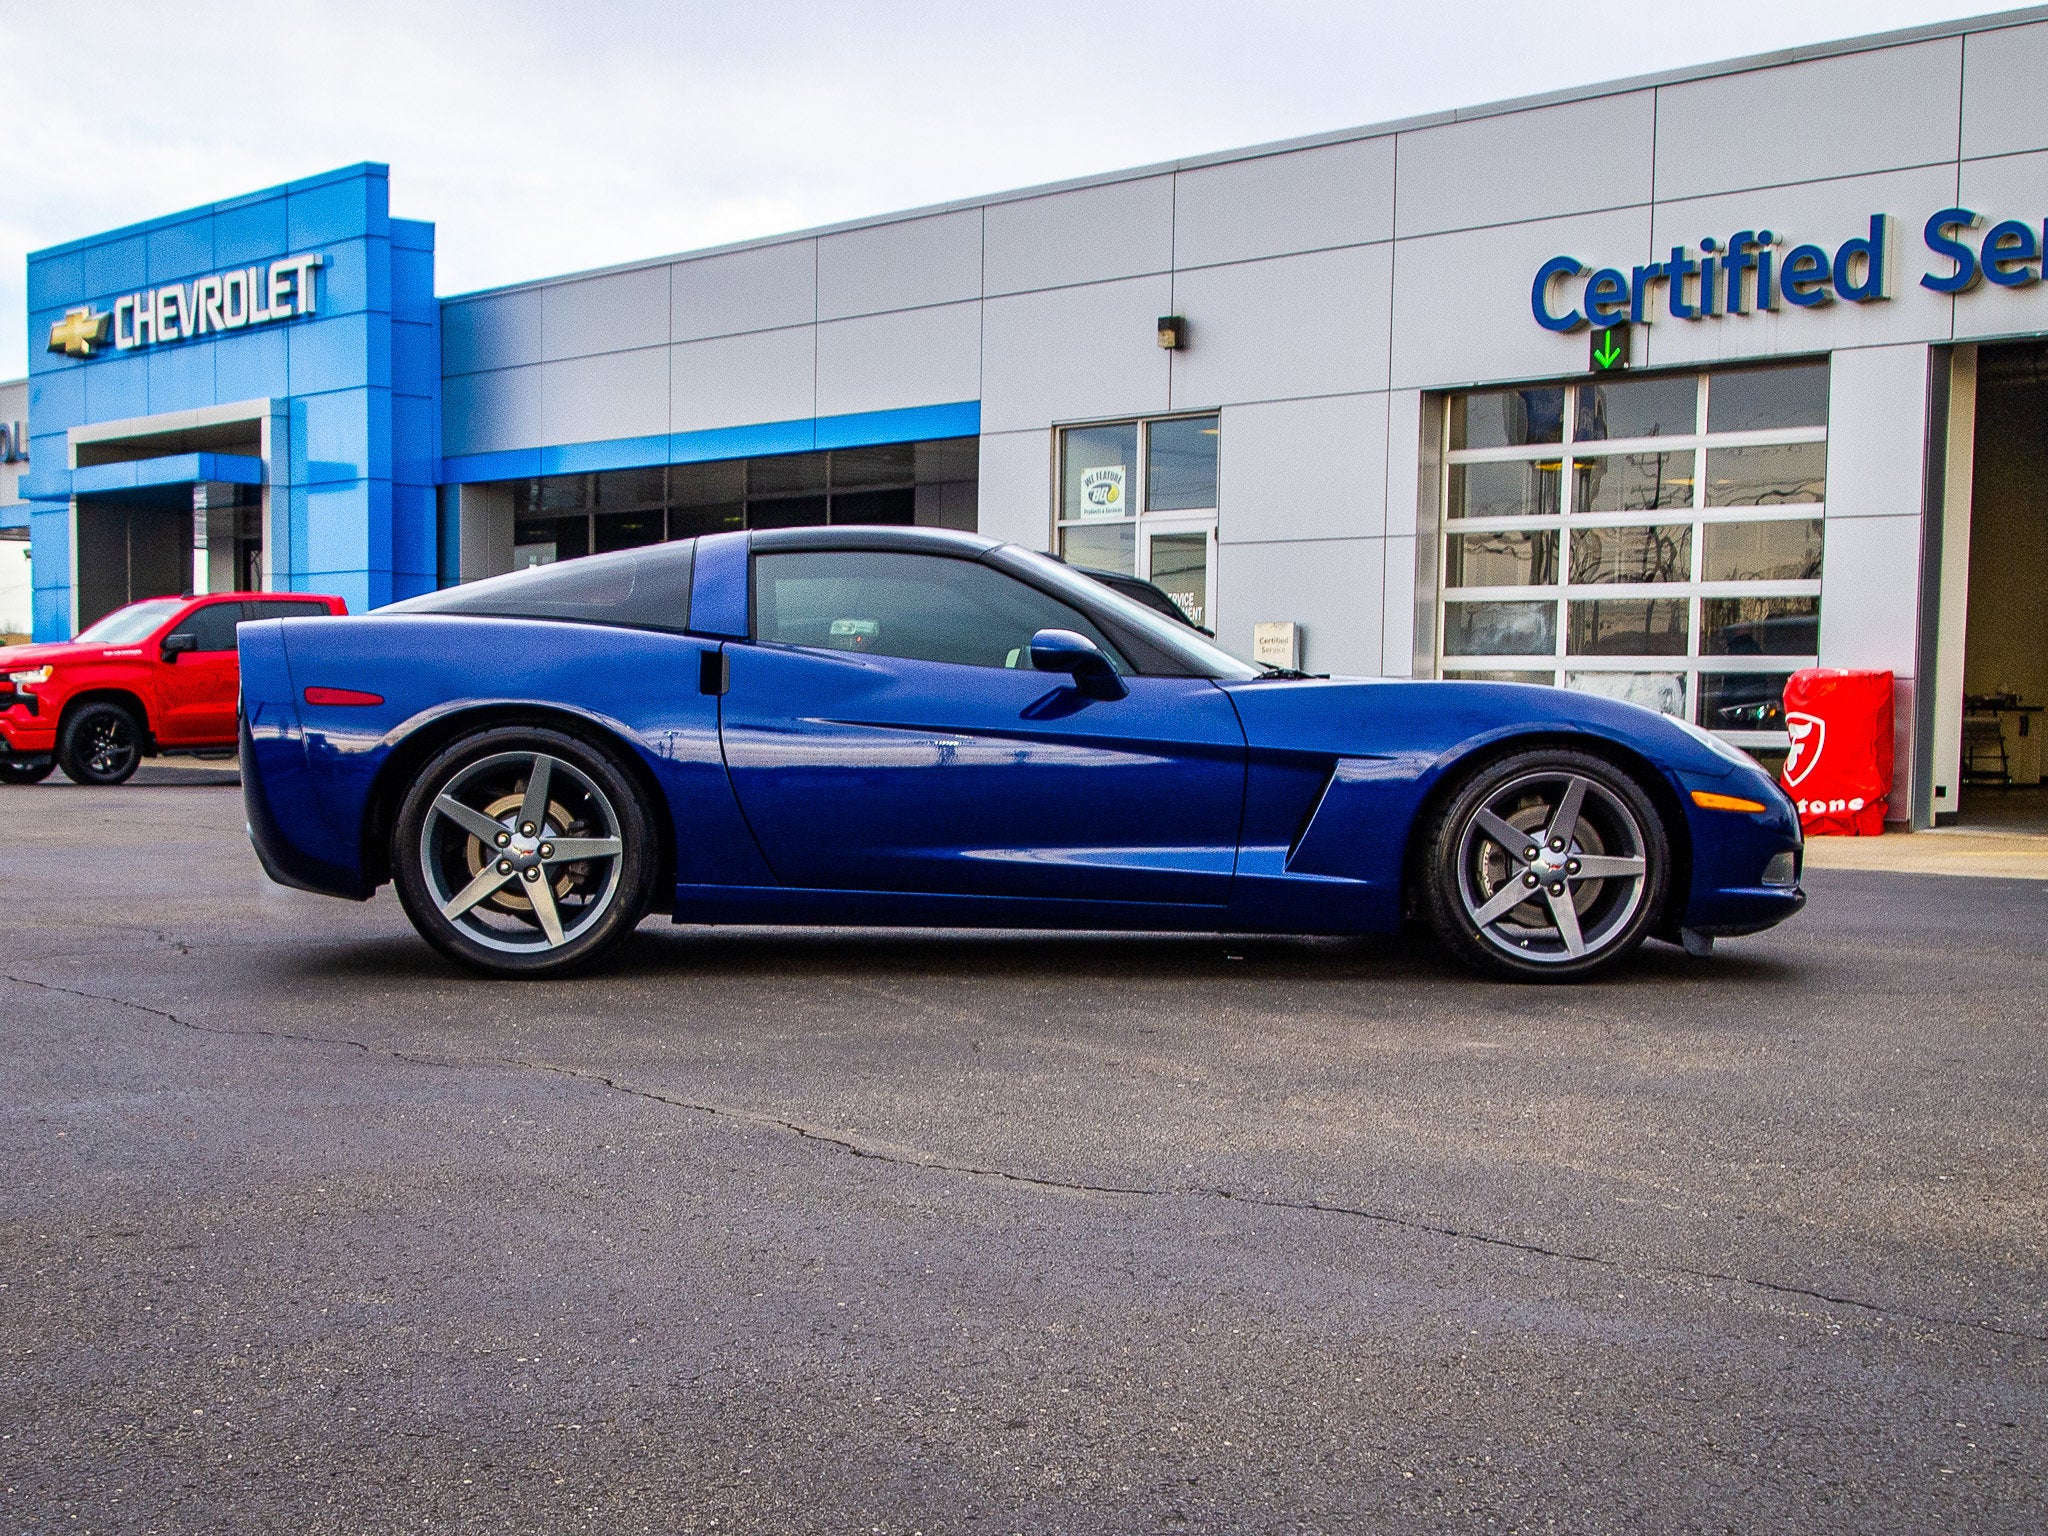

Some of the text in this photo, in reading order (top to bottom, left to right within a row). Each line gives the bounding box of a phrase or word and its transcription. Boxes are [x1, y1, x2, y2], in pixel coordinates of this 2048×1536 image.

[1532, 213, 1889, 332] Certified
[115, 253, 322, 350] CHEVROLET
[1084, 470, 1122, 487] WE FEATURE
[1259, 637, 1289, 645] Certified
